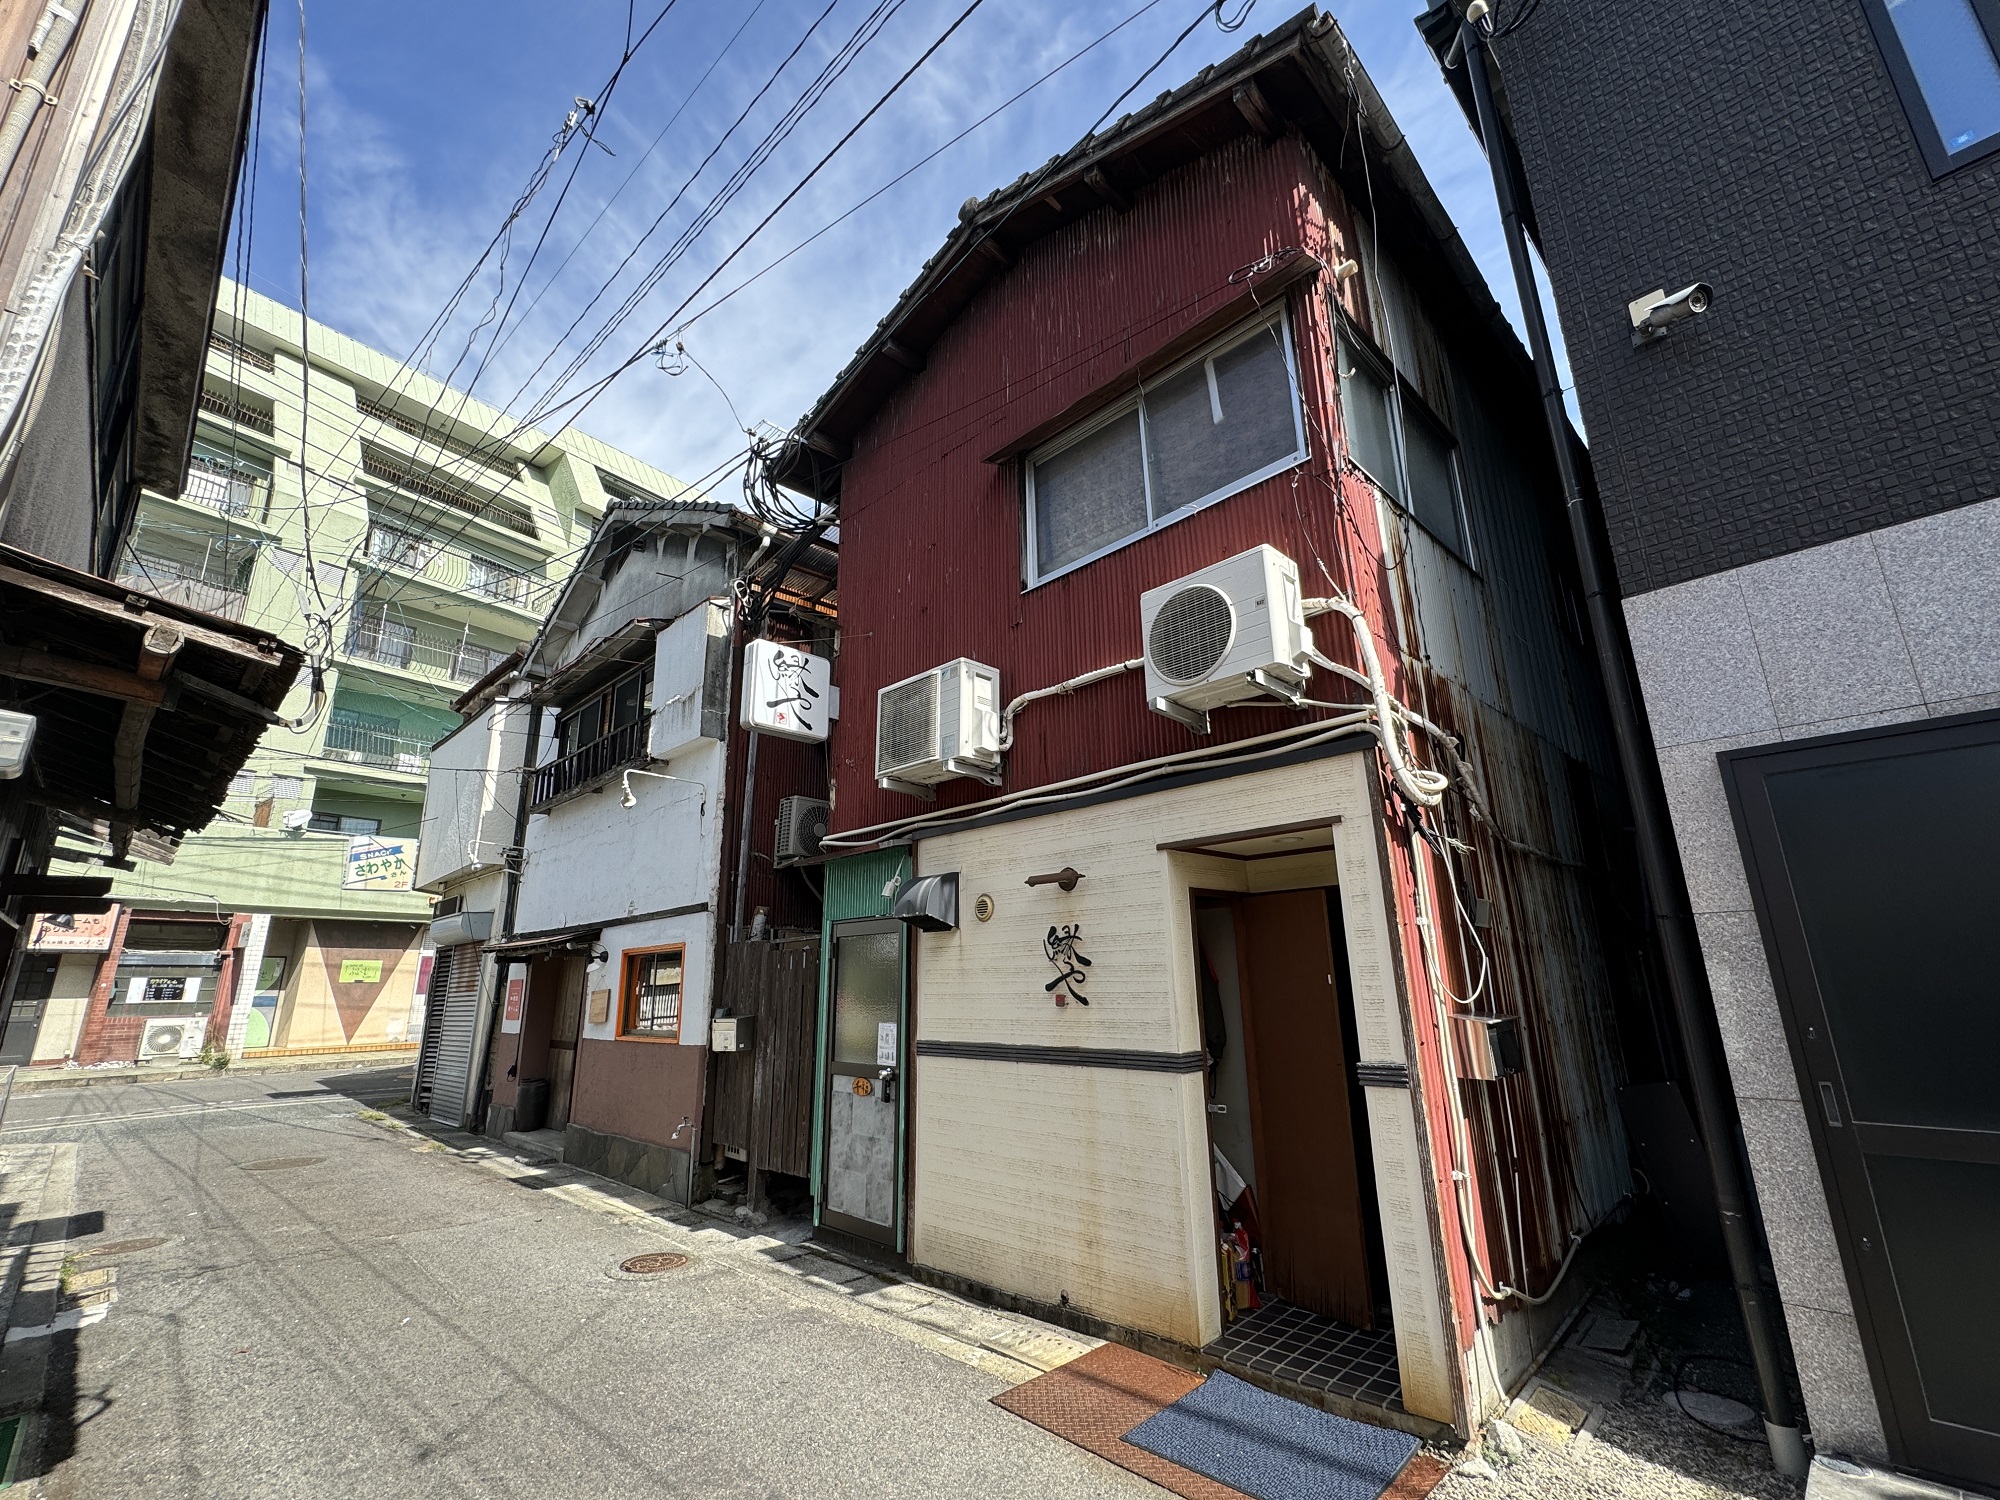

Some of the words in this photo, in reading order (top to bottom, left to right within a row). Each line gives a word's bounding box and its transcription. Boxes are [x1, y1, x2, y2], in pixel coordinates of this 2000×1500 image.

[360, 848, 393, 860] SNACK
[354, 858, 405, 876] さわやか
[394, 880, 408, 888] 2F
